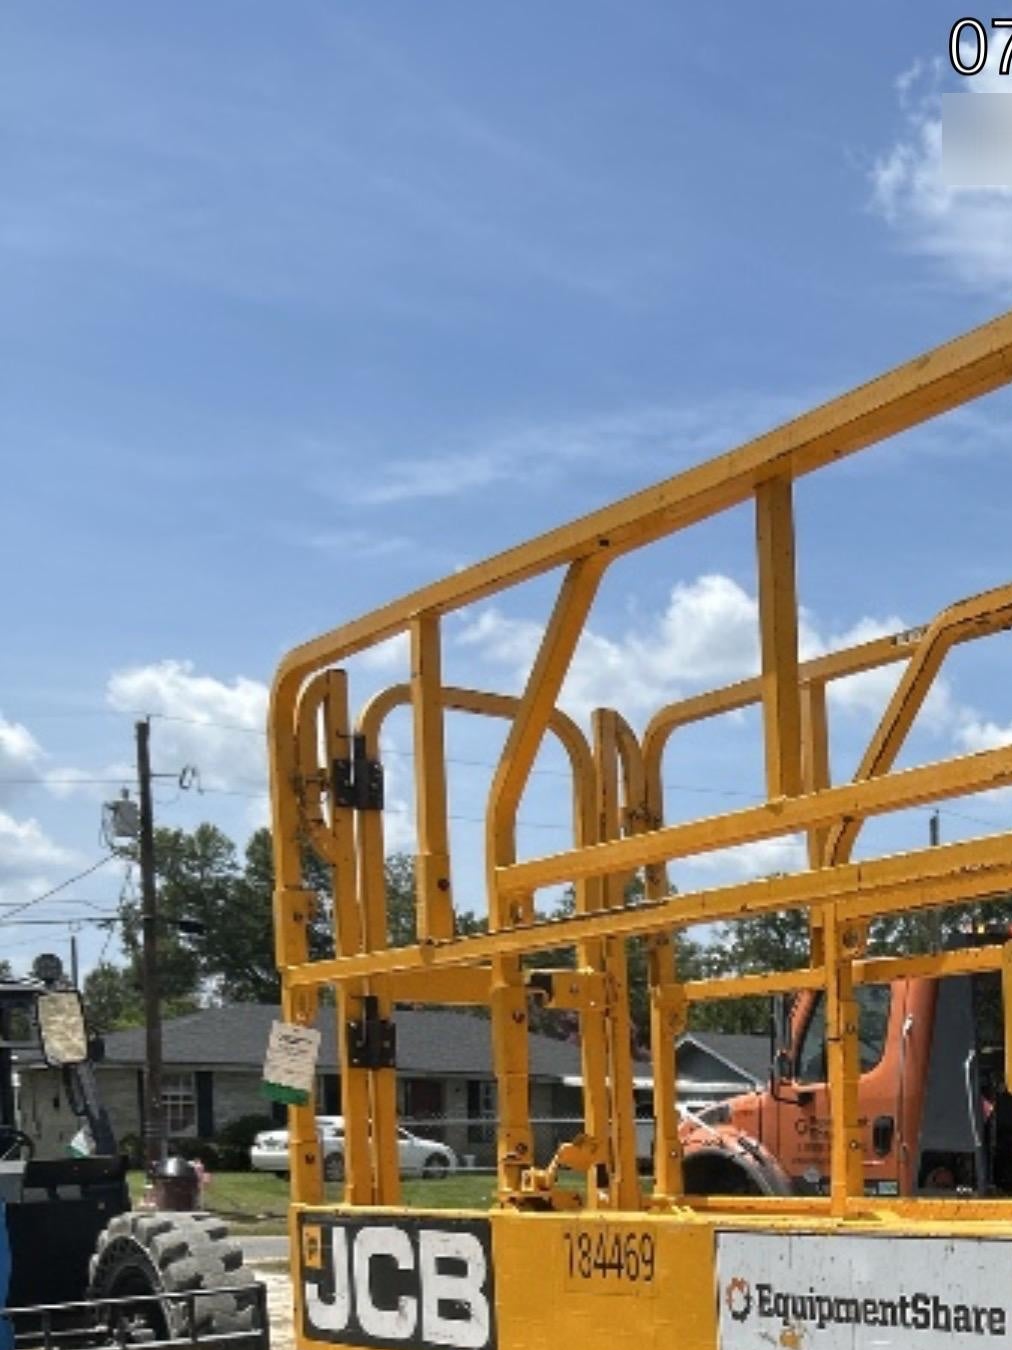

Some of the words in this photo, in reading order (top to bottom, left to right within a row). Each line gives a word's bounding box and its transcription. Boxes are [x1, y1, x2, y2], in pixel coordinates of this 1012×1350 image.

[563, 1232, 655, 1282] 184469
[304, 1226, 491, 1349] JCB
[755, 1283, 1007, 1336] EquipmentShare
